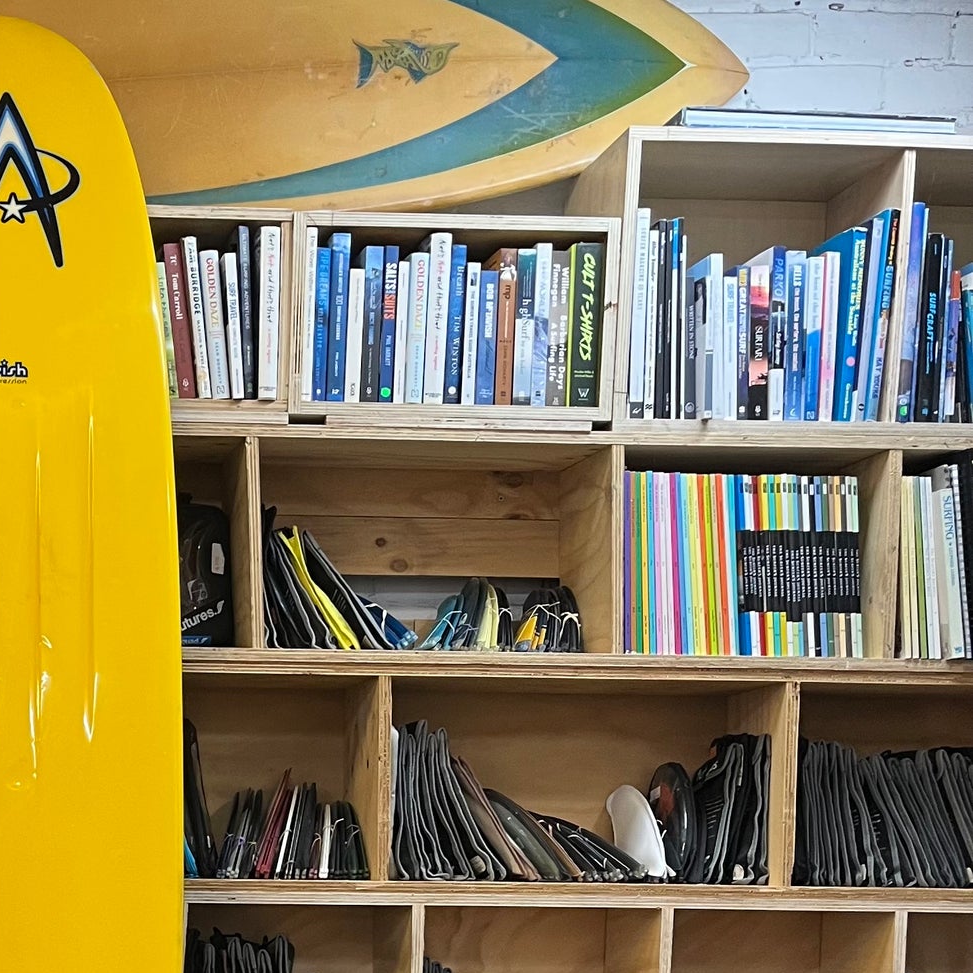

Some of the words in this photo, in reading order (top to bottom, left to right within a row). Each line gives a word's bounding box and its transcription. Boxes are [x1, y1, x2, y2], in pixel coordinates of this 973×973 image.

[170, 254, 177, 266] TC
[319, 250, 329, 268] PIPE
[582, 253, 596, 291] CULT
[171, 273, 181, 290] Tom
[206, 258, 215, 299] GOLDEN
[318, 271, 328, 305] DREAMS
[385, 263, 397, 290] SALTS
[416, 260, 425, 302] GOLDEN
[455, 266, 464, 296] Breath
[551, 264, 560, 308] Finnegan
[560, 267, 569, 304] William
[775, 258, 784, 296] PARKO
[793, 265, 802, 286] BELLS
[880, 265, 894, 309] SURFING
[190, 267, 201, 315] BURRIDGE
[228, 282, 236, 298] SURF
[335, 295, 343, 305] 100
[485, 283, 495, 299] BOB
[503, 285, 511, 299] mp
[173, 292, 183, 320] Carroll
[209, 302, 219, 327] DAZE
[229, 299, 238, 320] TRAVEL
[384, 294, 395, 320] SUITS
[415, 304, 423, 330] DAZE
[926, 292, 937, 342] SURFCRAFT
[453, 315, 461, 332] TIM
[579, 293, 595, 361] T-SHIRTS
[688, 332, 694, 340] IN
[549, 331, 558, 363] Surfing
[558, 315, 567, 363] Barbarian
[738, 332, 746, 354] SURF
[755, 326, 763, 361] SURFARI
[451, 337, 460, 376] WINTON
[549, 365, 557, 381] Life
[557, 366, 565, 390] Days
[943, 496, 954, 540] SURFING
[181, 606, 219, 631] utures.
